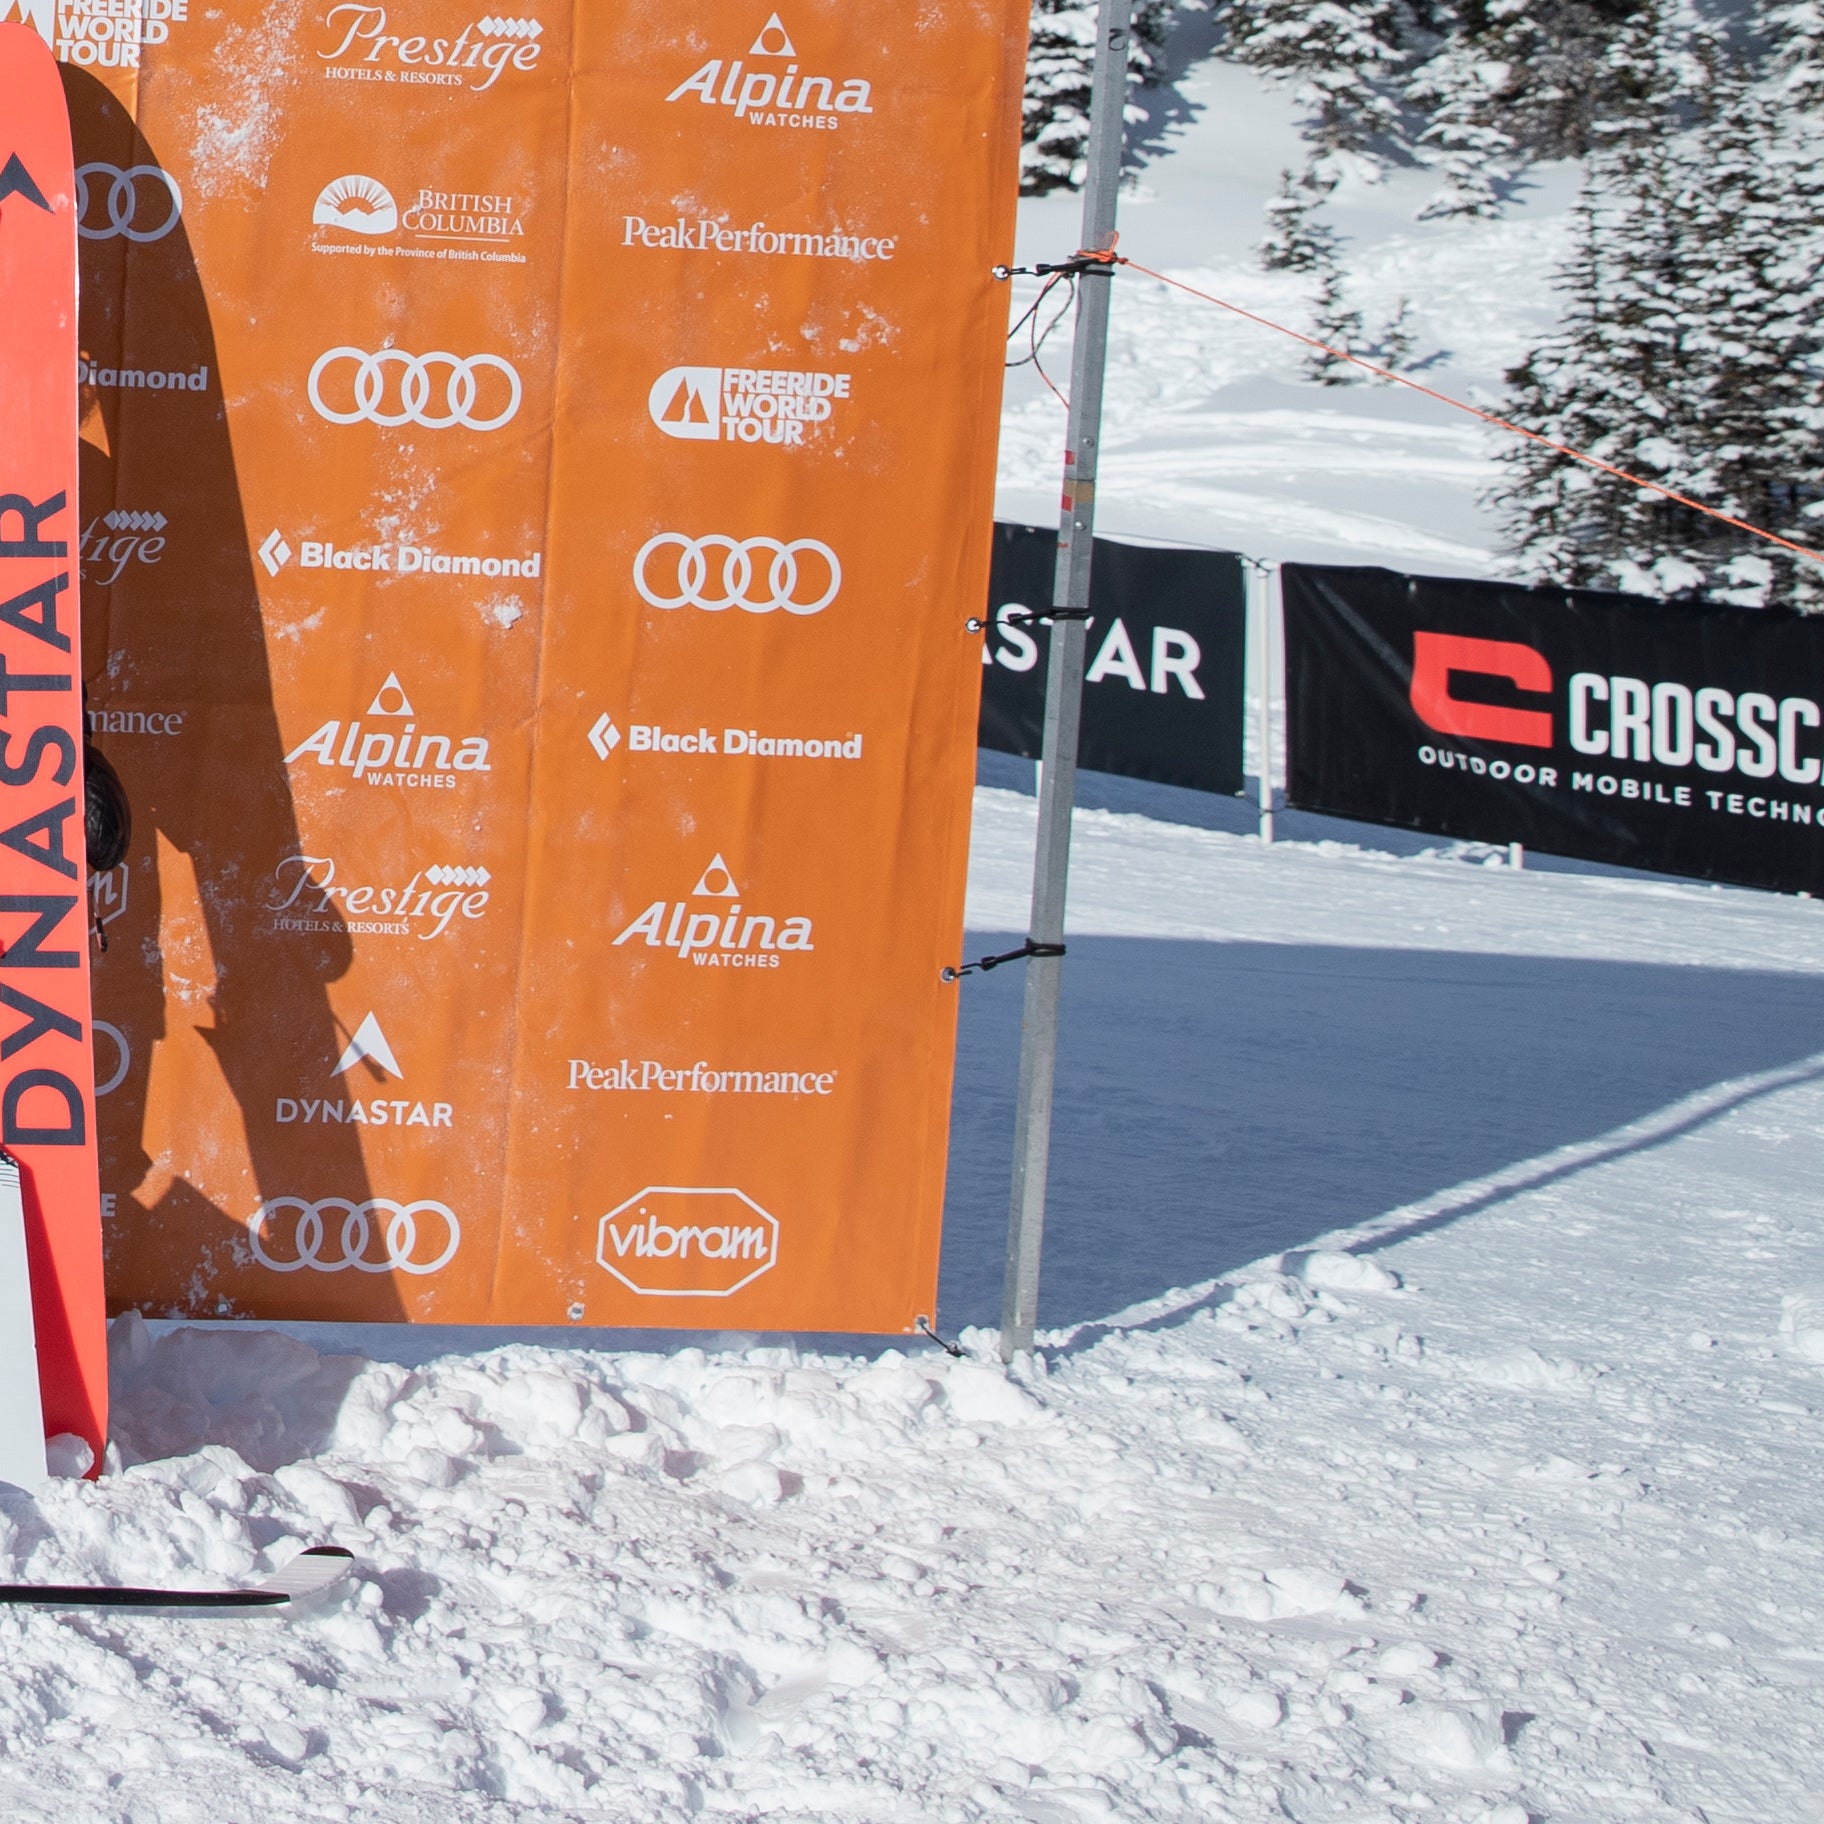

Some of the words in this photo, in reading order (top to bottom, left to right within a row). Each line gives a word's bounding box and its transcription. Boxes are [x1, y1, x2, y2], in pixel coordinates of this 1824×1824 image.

[58, 15, 169, 45] WORLD
[56, 38, 140, 67] TOUR
[317, 3, 541, 91] Prestige
[325, 66, 382, 81] HOTELS
[400, 70, 462, 85] RESORTS
[665, 59, 873, 118] Alpina
[749, 113, 838, 130] WATCHES
[418, 188, 512, 214] BRITISH
[402, 210, 524, 236] COLUMBIA
[311, 242, 361, 256] Supported
[363, 246, 375, 257] by
[377, 246, 393, 256] the
[395, 247, 435, 258] Province
[436, 249, 447, 259] of
[449, 250, 478, 261] British
[480, 252, 526, 263] Columbia
[723, 368, 850, 399] FREERIDE
[722, 392, 831, 421] WORLD
[722, 416, 804, 445] TOUR
[300, 541, 390, 572] Black
[397, 545, 541, 578] Diamond
[629, 724, 717, 755] Black
[723, 727, 863, 759] Diamond
[1569, 672, 1824, 787] CROSSC
[284, 721, 491, 778] Alpina
[367, 772, 456, 789] WATCHES
[1418, 745, 1557, 787] OUTDOOR
[1572, 773, 1691, 807] MOBILE
[266, 855, 492, 940] Prestige
[273, 919, 329, 932] HOTELS
[346, 920, 410, 936] RESORTS
[612, 901, 814, 960] Alpina
[693, 951, 780, 969] WATCHES
[276, 1099, 453, 1128] DYNASTAR
[608, 1207, 769, 1261] vibram
